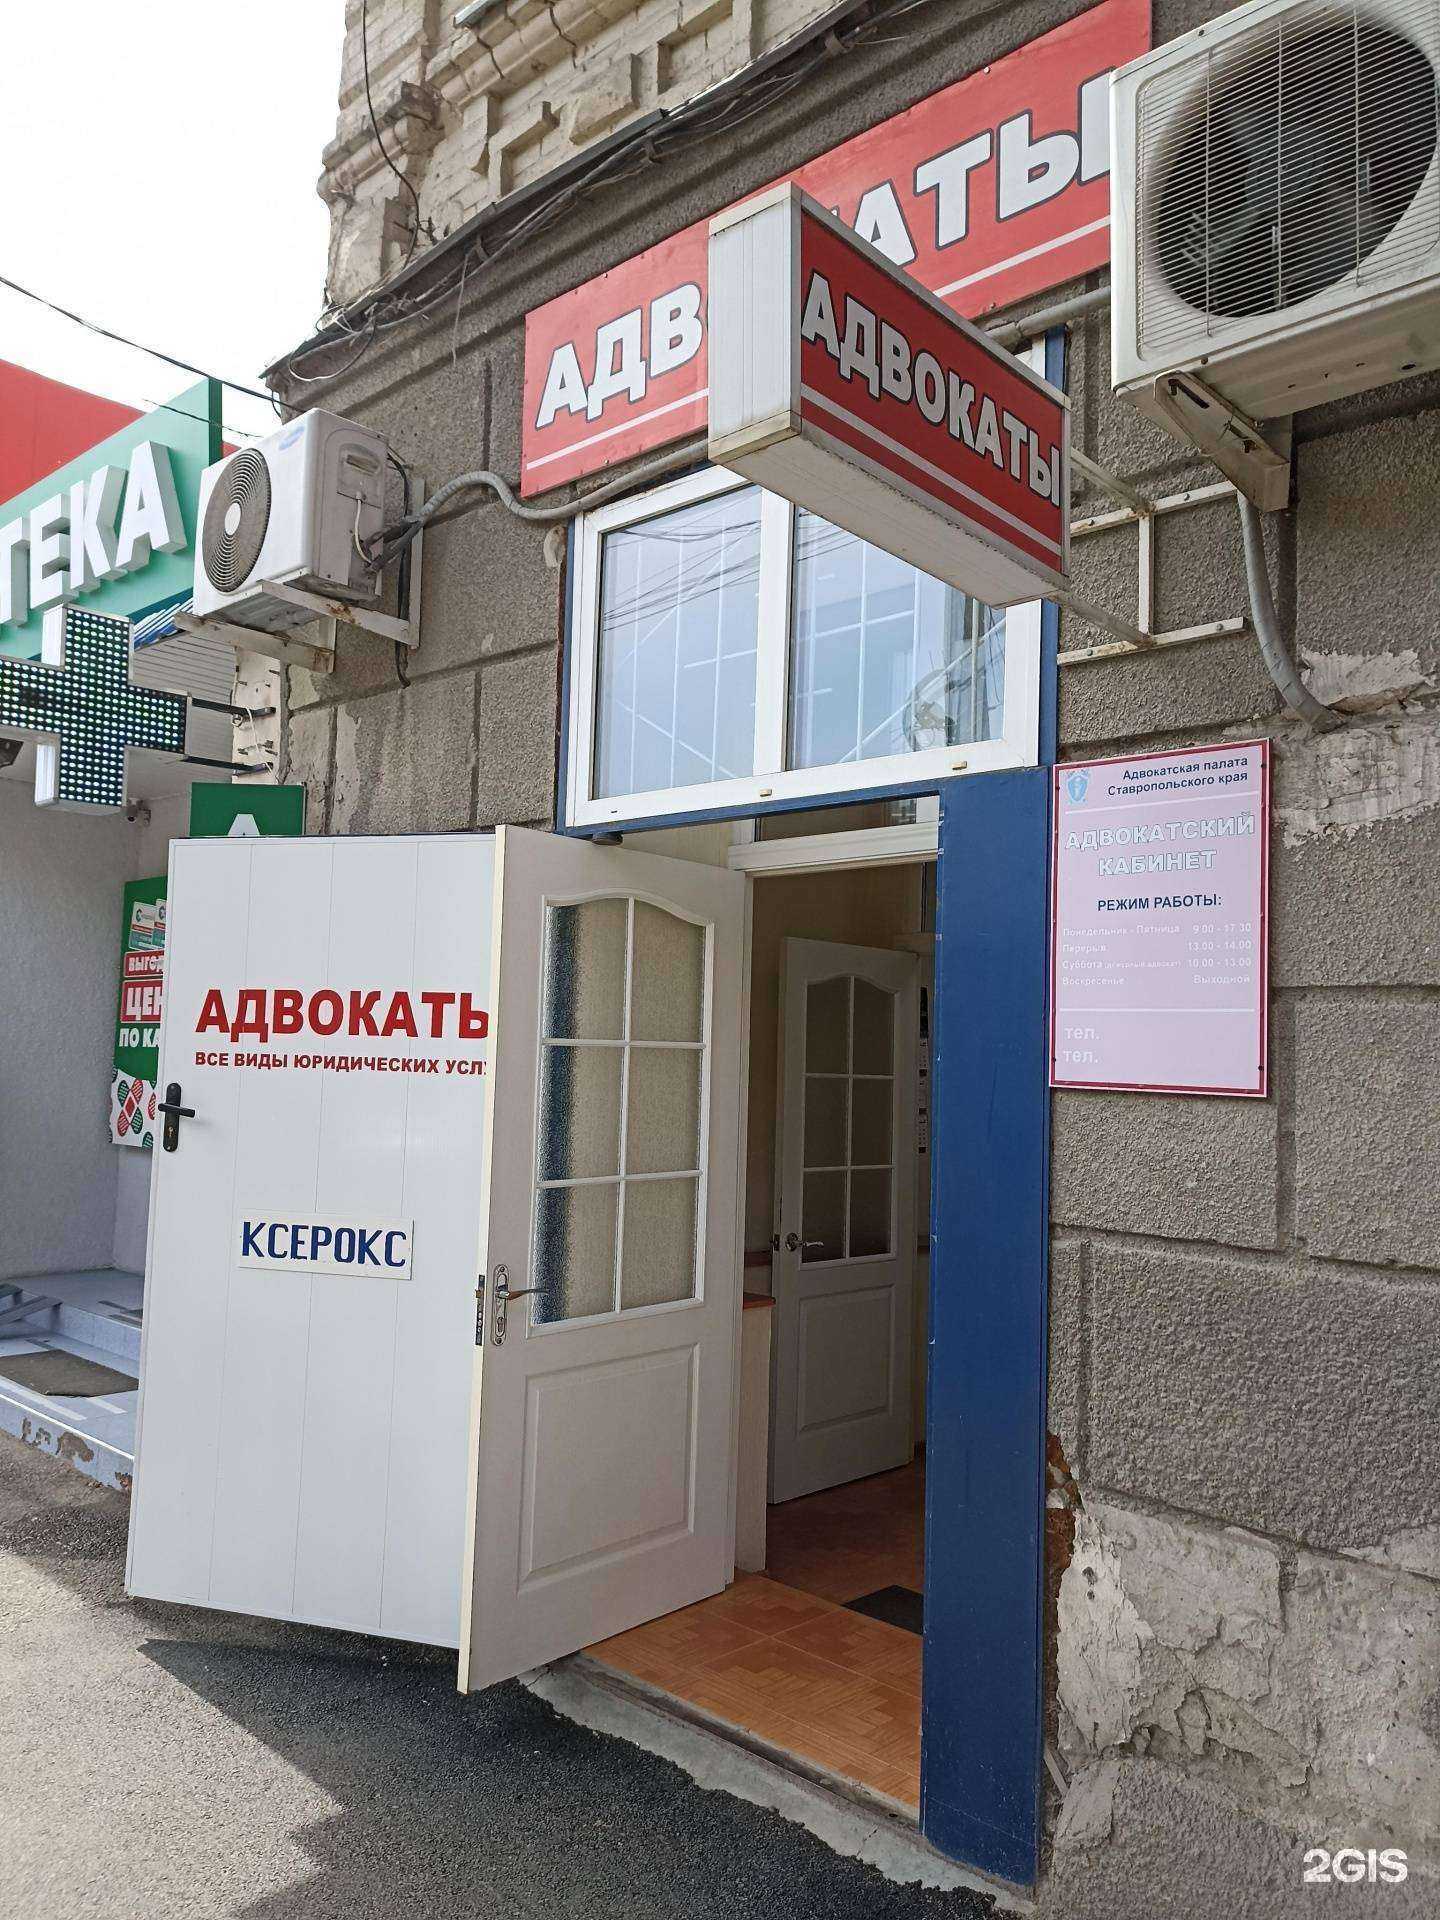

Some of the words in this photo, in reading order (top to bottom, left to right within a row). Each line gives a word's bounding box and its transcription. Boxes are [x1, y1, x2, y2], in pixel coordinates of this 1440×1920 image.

[535, 68, 1111, 432] АДВАТЫ
[801, 272, 1062, 506] АДВОКАТЫ
[1122, 764, 1200, 781] Адвокатская
[1203, 757, 1249, 771] палата
[1107, 775, 1215, 797] Ставропольского
[1218, 771, 1249, 786] края
[1064, 811, 1256, 850] АДВОКАТСКИЙ
[1098, 850, 1218, 877] КАБИНЕТ
[1097, 897, 1150, 912] РЕЖИМ
[1153, 893, 1223, 909] РАБОТЫ:
[118, 1027, 140, 1048] ПО
[1064, 1027, 1100, 1041] тел.
[195, 1051, 229, 1067] ВСЕ
[234, 1053, 289, 1070] ВИДЫ
[293, 1055, 440, 1074] ЮРИДИЧЕСКИХ
[445, 1059, 487, 1076] УСЛ
[1062, 1049, 1100, 1063] тел.
[241, 1221, 407, 1268] КСЕРОКС
